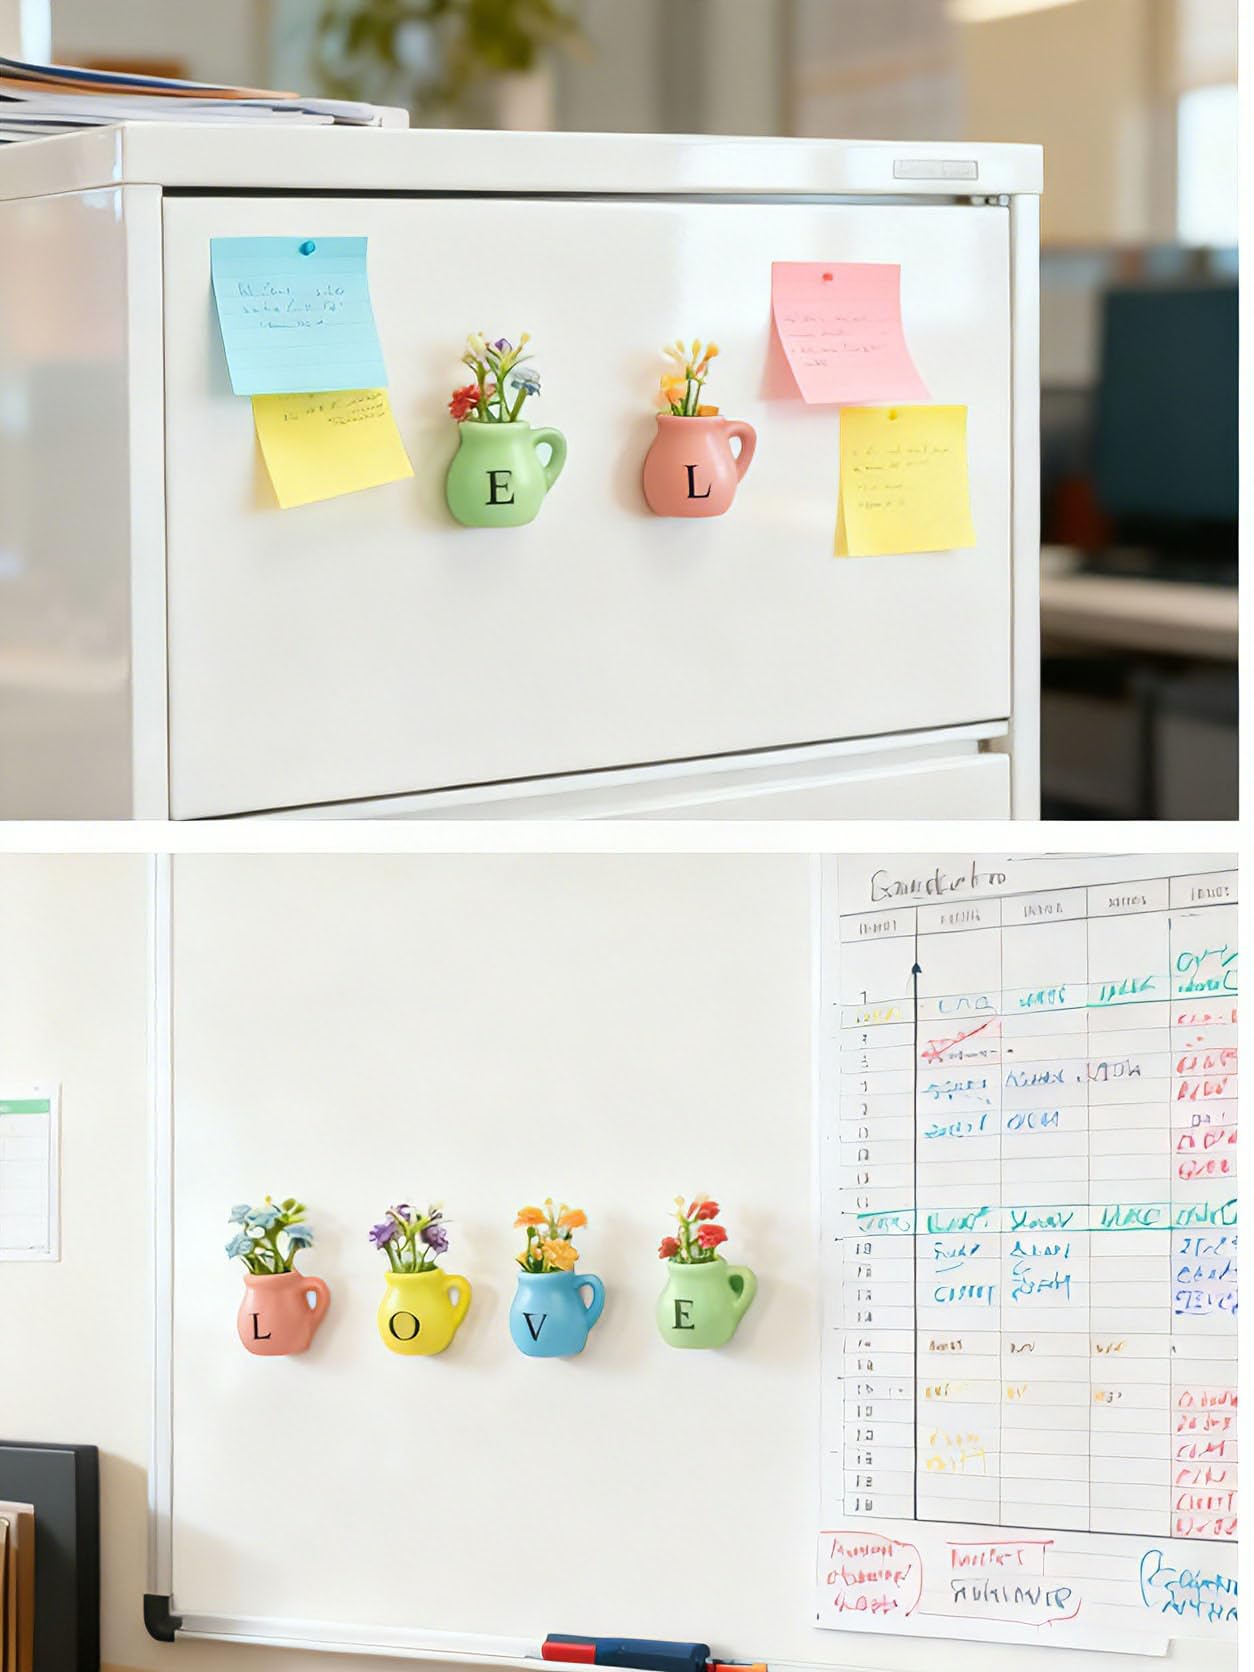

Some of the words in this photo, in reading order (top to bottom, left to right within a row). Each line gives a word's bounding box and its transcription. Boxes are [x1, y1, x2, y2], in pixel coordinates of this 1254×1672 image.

[485, 470, 515, 506] E
[685, 464, 711, 499] L
[252, 1313, 272, 1340] L
[388, 1312, 421, 1341] O
[523, 1312, 547, 1342] V
[672, 1299, 696, 1330] E
